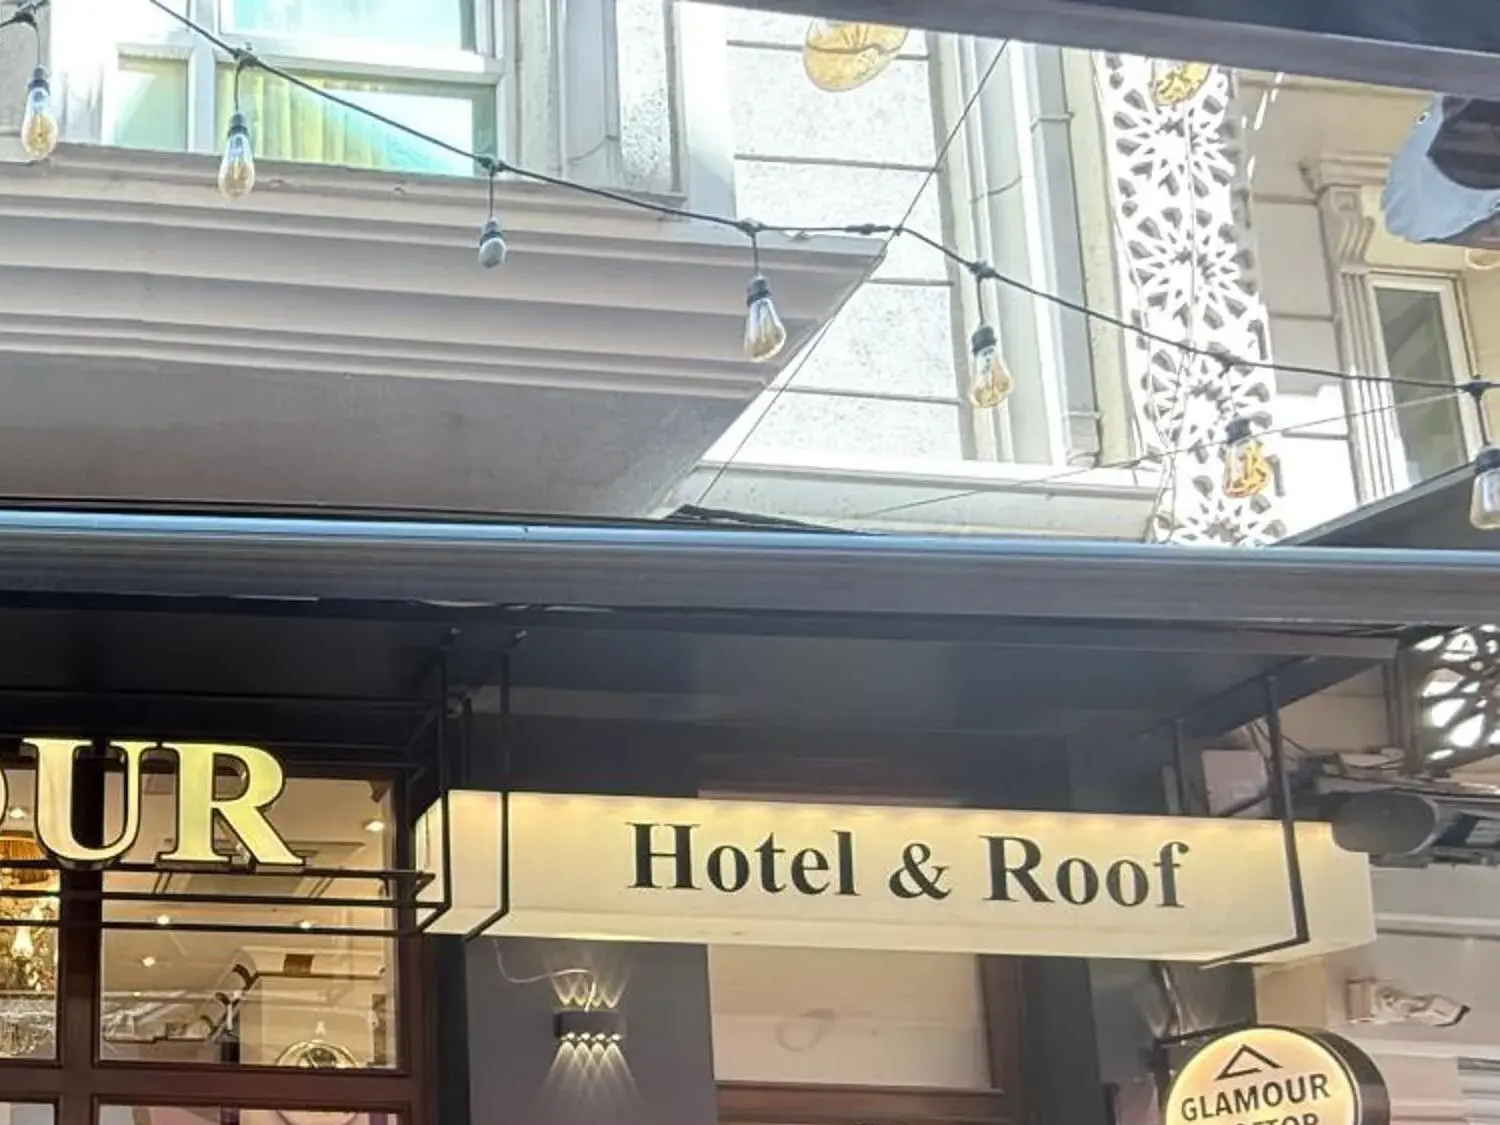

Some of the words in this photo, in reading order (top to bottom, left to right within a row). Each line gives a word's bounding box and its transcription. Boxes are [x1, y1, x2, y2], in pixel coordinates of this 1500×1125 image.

[625, 821, 861, 896] Hotel
[889, 842, 952, 901] &
[979, 834, 1190, 908] Roof
[1181, 1073, 1331, 1121] GLAMOUR
